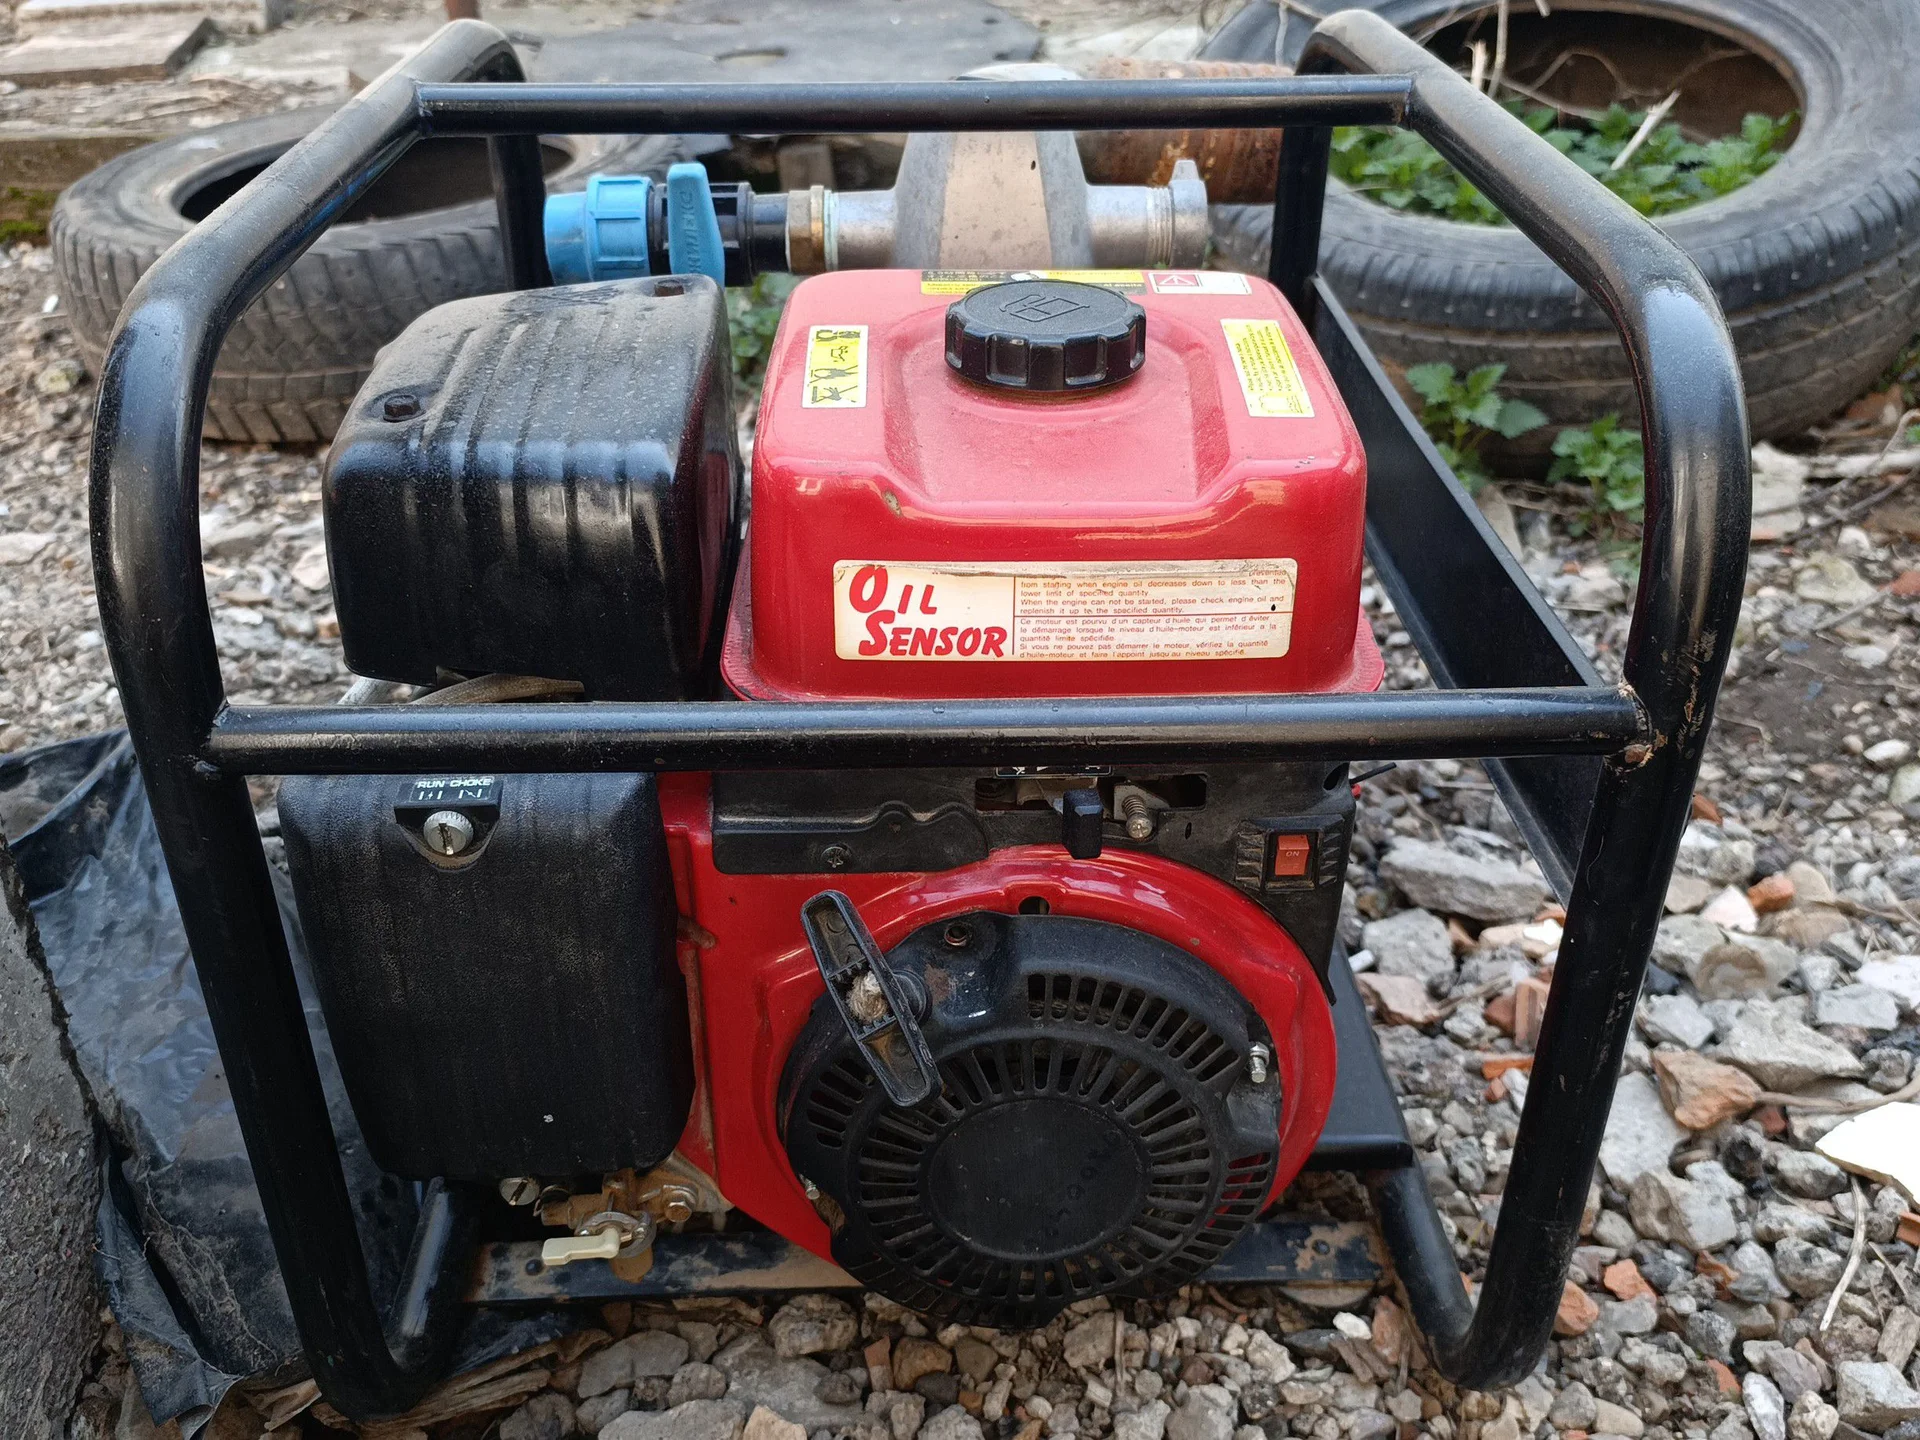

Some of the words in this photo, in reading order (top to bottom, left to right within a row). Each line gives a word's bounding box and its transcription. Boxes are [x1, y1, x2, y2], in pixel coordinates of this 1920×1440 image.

[849, 564, 938, 614] OIL
[1043, 581, 1072, 589] starting
[1102, 581, 1128, 589] engine
[1133, 580, 1142, 588] oil
[1147, 580, 1187, 588] decreases
[1191, 579, 1213, 587] down
[1020, 589, 1041, 597] lower
[1061, 599, 1087, 607] engine
[1171, 597, 1197, 605] please
[1228, 596, 1254, 604] engine
[1020, 607, 1055, 615] replenish
[1059, 607, 1066, 615] it
[1112, 606, 1148, 614] specified
[1081, 618, 1108, 626] pourvu
[1132, 617, 1161, 625] capteur
[1194, 616, 1207, 624] qui
[1210, 615, 1237, 623] permet
[858, 609, 1008, 658] SENSOR
[1020, 626, 1028, 634] le
[1031, 626, 1072, 635] démarrage
[1075, 626, 1104, 635] lorsque
[1208, 624, 1221, 632] est
[1224, 623, 1256, 631] inférieur
[1020, 635, 1051, 643] quantité
[1115, 642, 1149, 650] démarrer
[1195, 641, 1223, 649] vérifiez
[1226, 640, 1234, 648] la
[1237, 639, 1269, 648] quantité
[417, 780, 445, 788] RUN
[449, 778, 491, 787] CHOKE
[1285, 850, 1301, 858] ON
